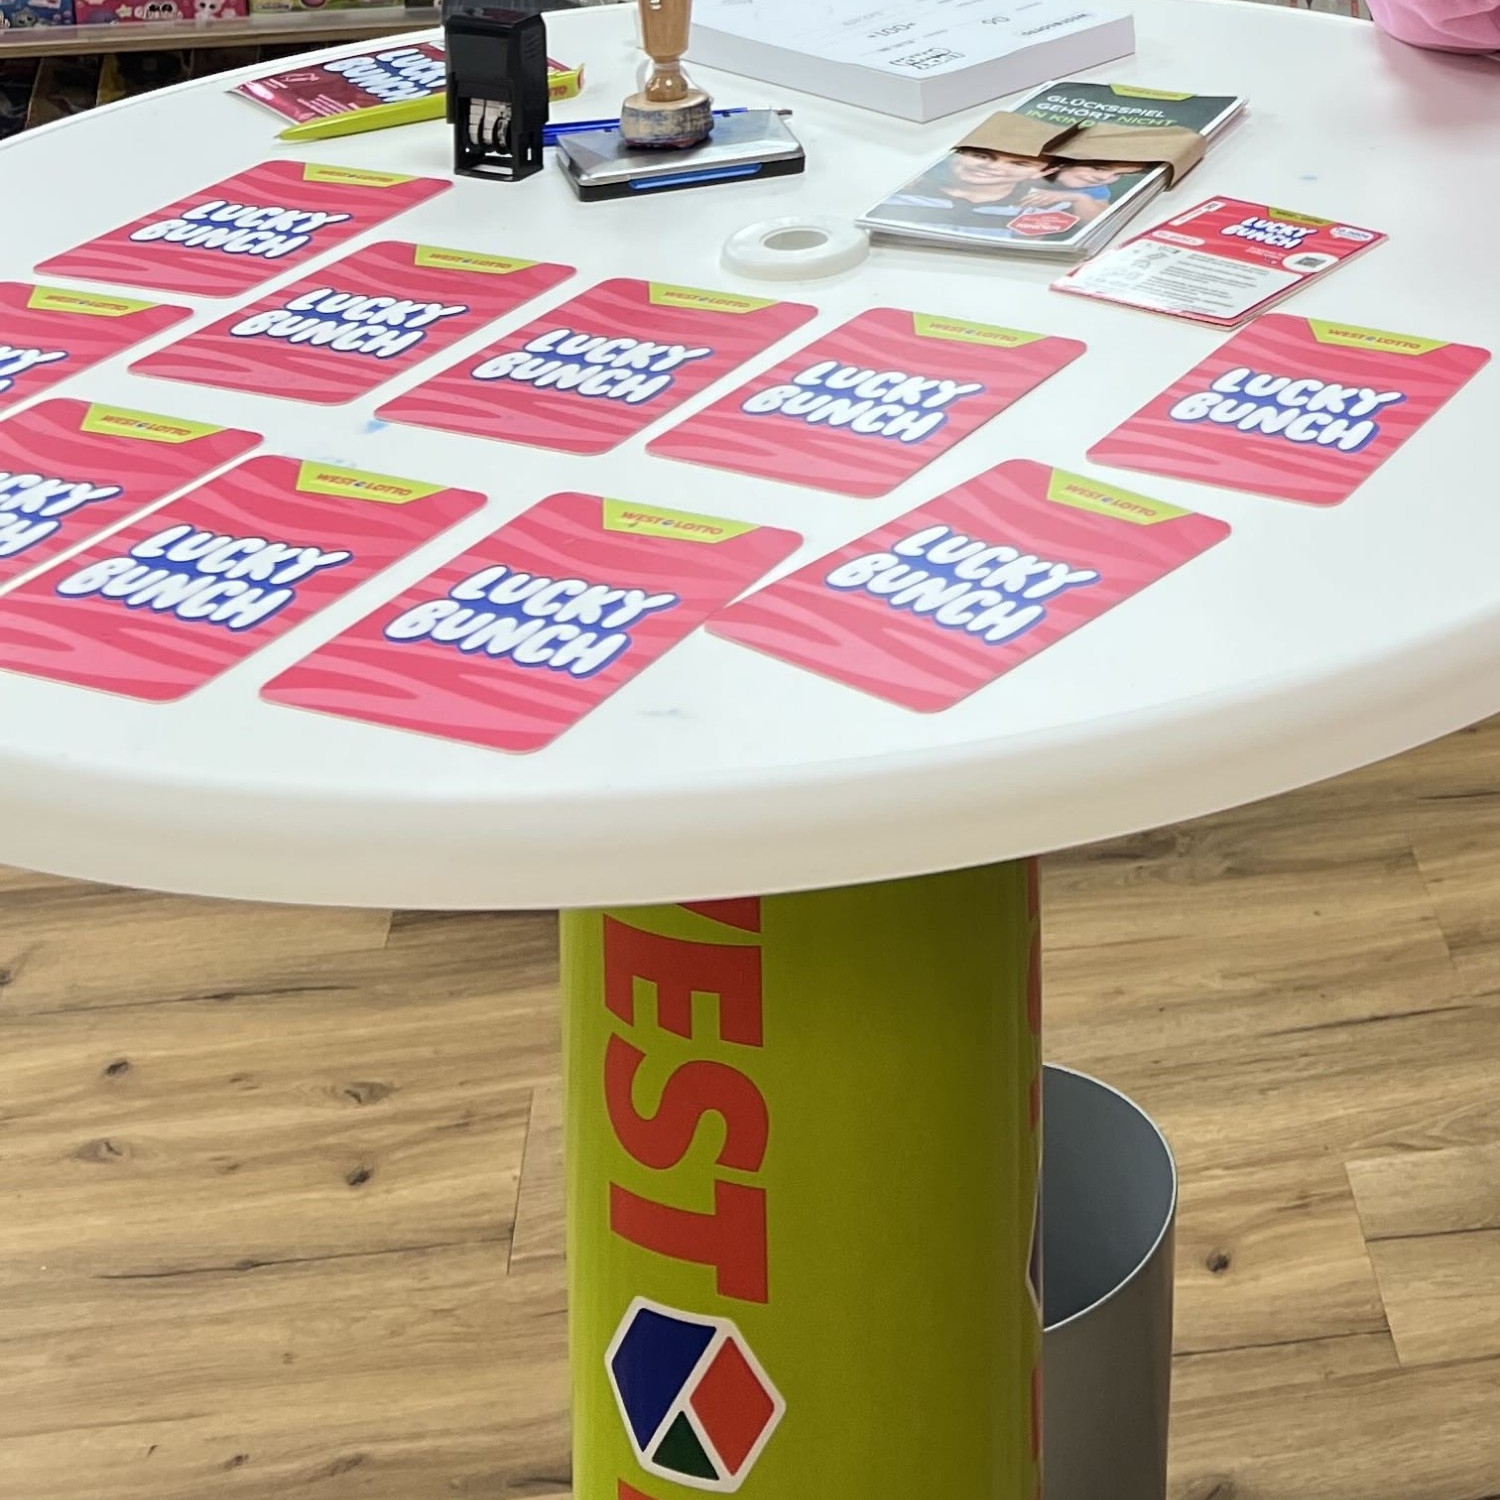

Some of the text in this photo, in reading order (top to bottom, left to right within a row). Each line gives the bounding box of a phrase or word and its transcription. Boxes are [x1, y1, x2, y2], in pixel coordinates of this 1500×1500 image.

[1026, 110, 1043, 121] IN
[1036, 101, 1177, 128] GEHÖRT NICHT
[1046, 94, 1166, 119] GLÜCKSSPIEL
[130, 219, 310, 258] BUNCH
[182, 201, 352, 233] LUCKY
[1220, 225, 1303, 250] BUNCH
[1241, 217, 1317, 238] LUCKY
[287, 288, 467, 329] LUCKY
[230, 309, 424, 358] BUNCH
[526, 329, 711, 370] LUCKY
[472, 352, 671, 404] BUNCH
[793, 360, 984, 409] LUCKY
[1211, 367, 1405, 416] LUCKY
[741, 384, 945, 442] BUNCH
[1170, 392, 1375, 450] BUNCH
[131, 524, 352, 585] LUCKY
[893, 526, 1099, 599] LUCKY
[56, 557, 293, 629] BUNCH
[451, 566, 677, 629] LUCKY
[826, 553, 1045, 642] BUNCH
[385, 599, 628, 675] BUNCH
[603, 894, 769, 1304] EST
